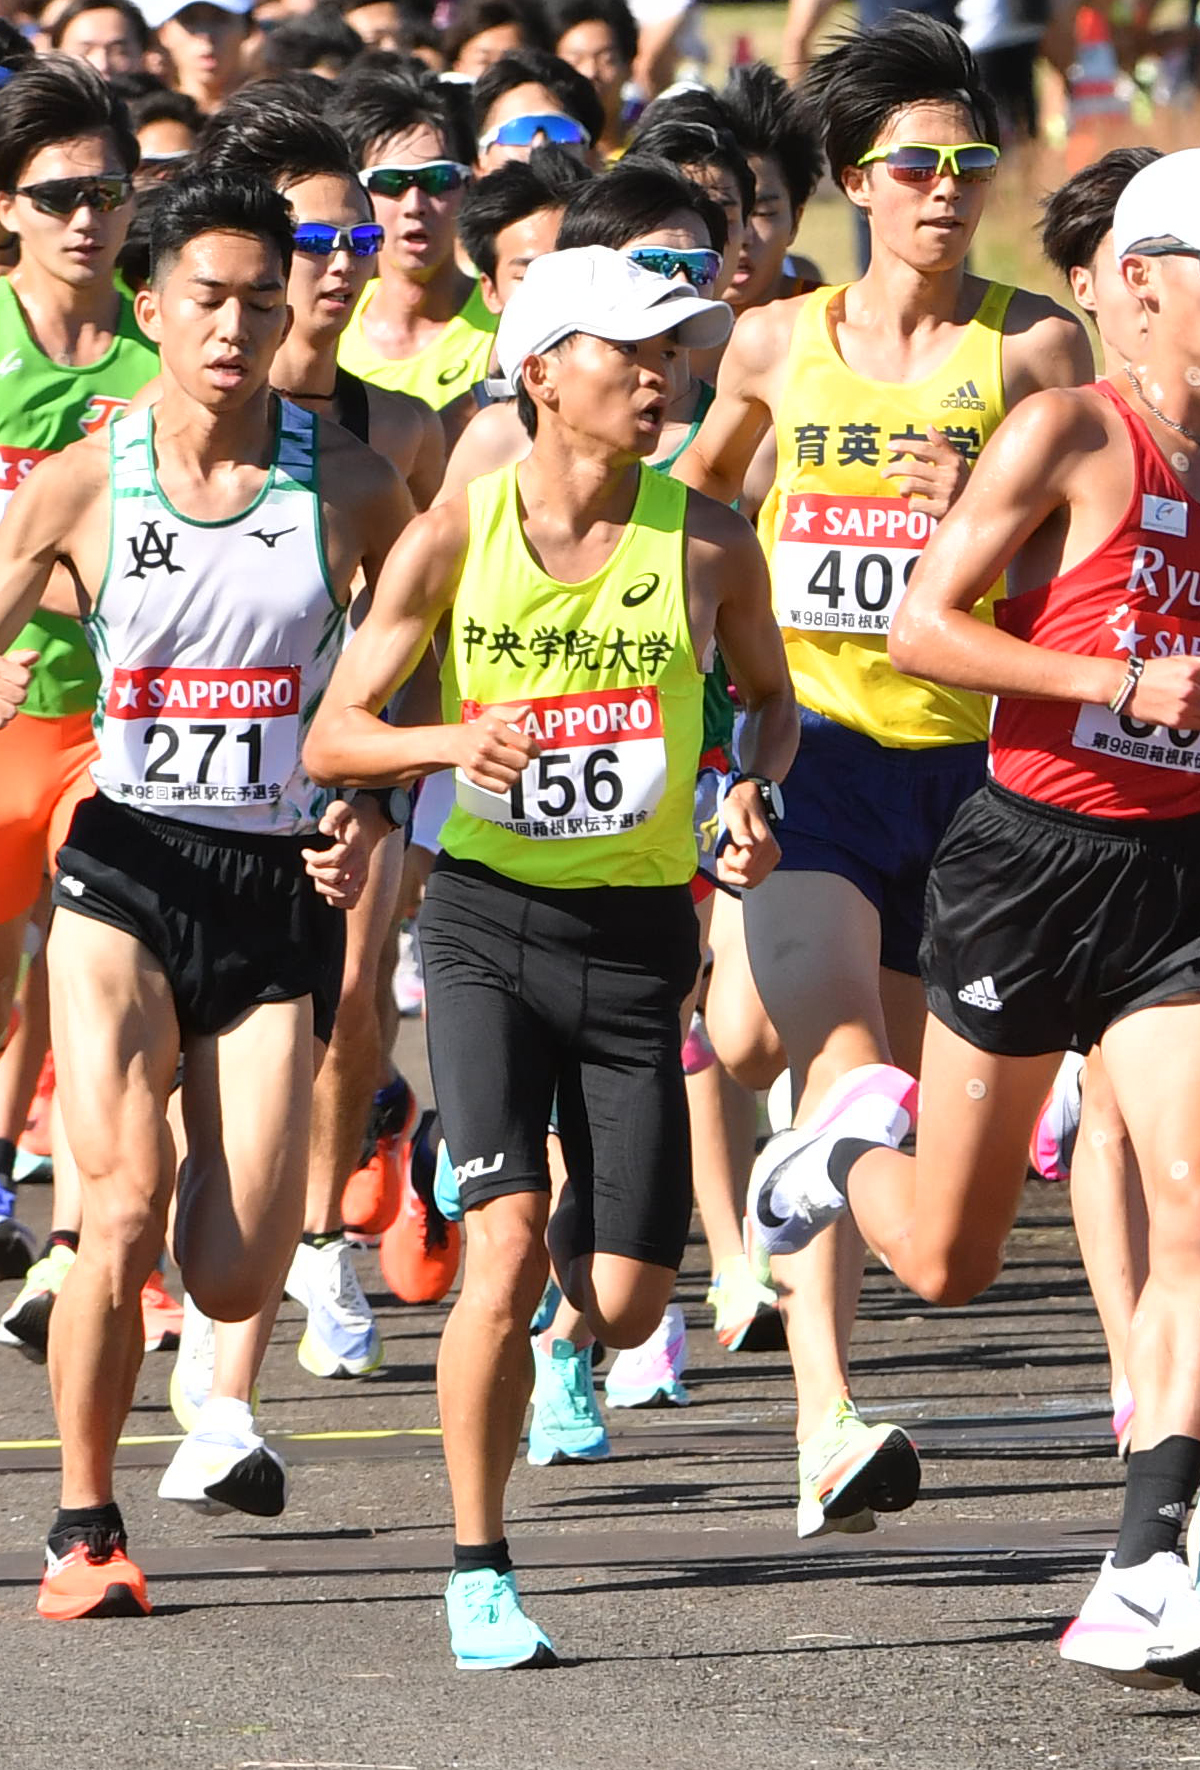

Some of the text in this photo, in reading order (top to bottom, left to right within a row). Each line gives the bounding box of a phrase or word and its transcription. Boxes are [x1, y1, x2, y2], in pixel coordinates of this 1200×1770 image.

[940, 397, 986, 411] adidas
[794, 422, 981, 468] 育英大学
[824, 507, 937, 540] SAPPO
[807, 550, 921, 612] 40
[463, 616, 675, 676] 中央学院大学
[148, 678, 292, 709] SAPPORO
[506, 698, 653, 741] APPORO
[144, 724, 262, 784] 271
[510, 749, 624, 820] 156
[958, 990, 1003, 1011] adidas
[453, 1153, 504, 1187] XU
